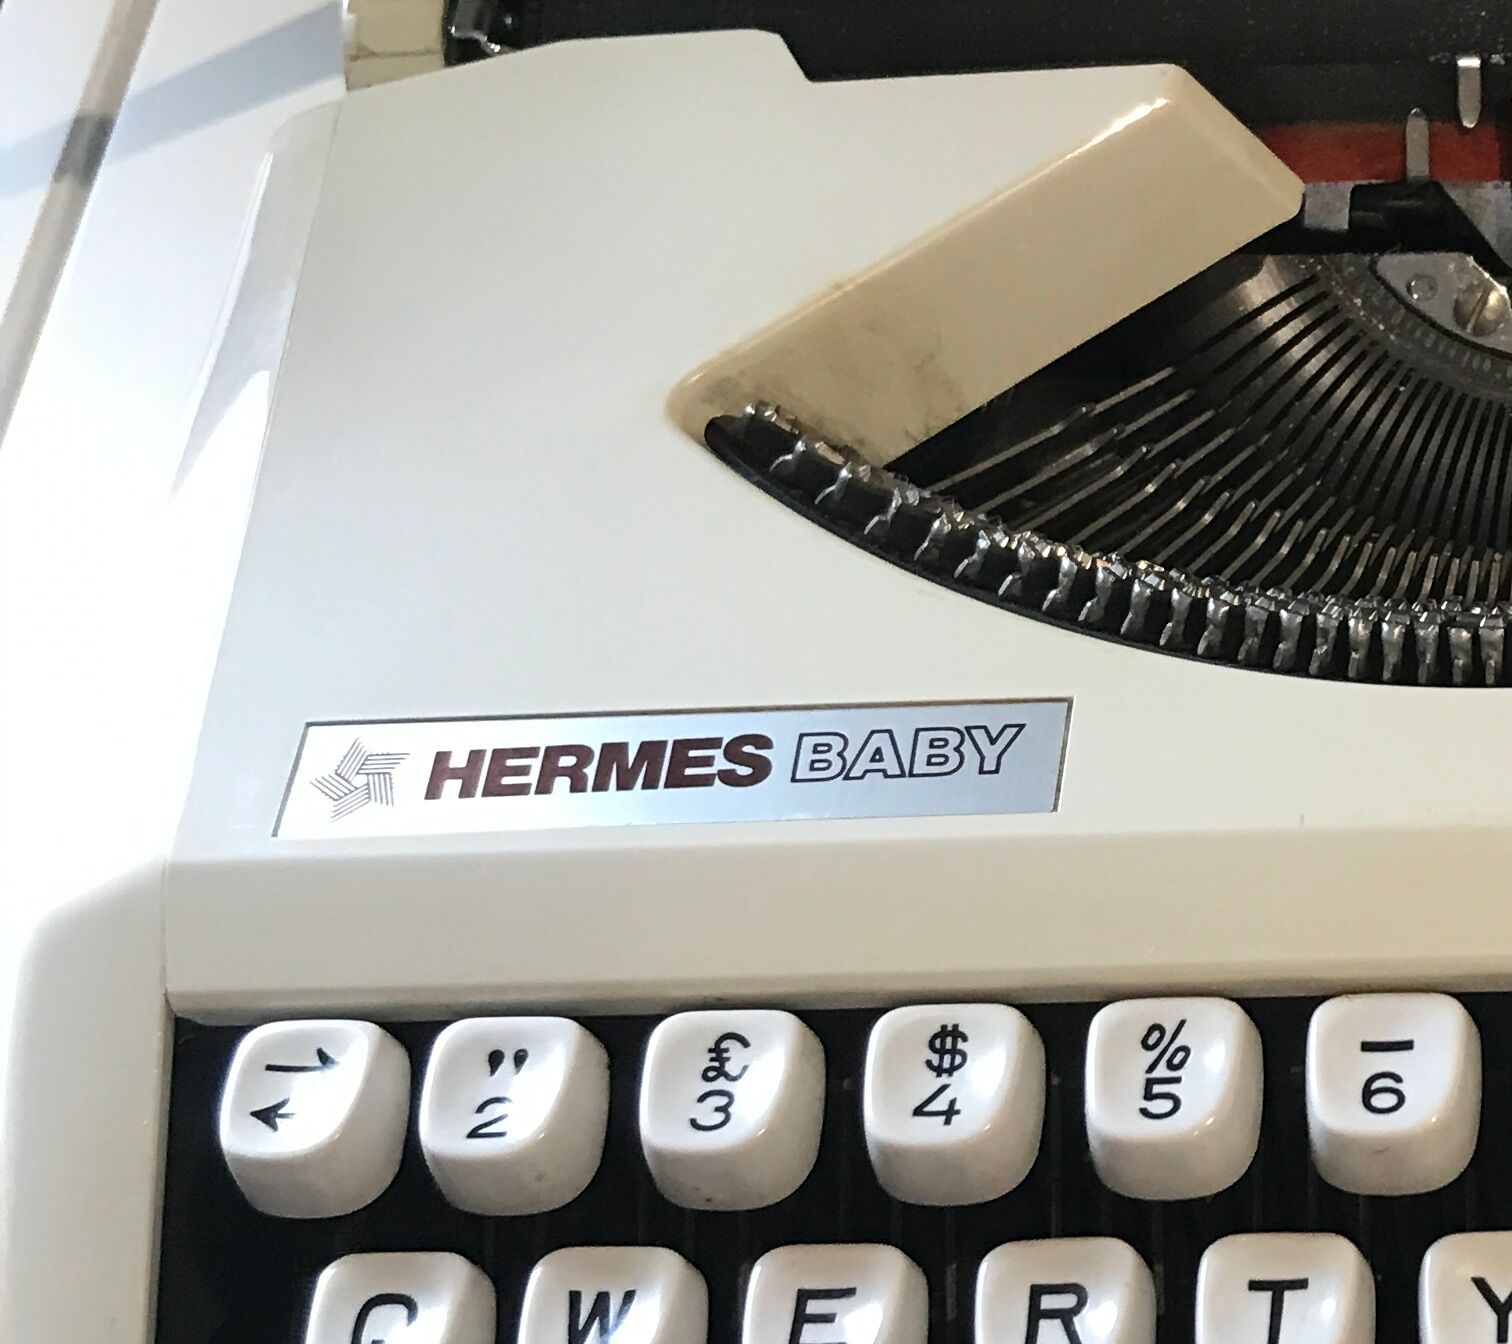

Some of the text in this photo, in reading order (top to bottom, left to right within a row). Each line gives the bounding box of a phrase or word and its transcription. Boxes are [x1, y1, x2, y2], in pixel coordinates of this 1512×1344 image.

[423, 723, 1026, 801] HERMES BABY
[701, 1031, 751, 1083] £
[924, 1023, 969, 1078] $
[1140, 1019, 1191, 1075] %
[689, 1089, 734, 1132] 3
[912, 1083, 961, 1126] 4
[1138, 1076, 1182, 1120] 5
[1361, 1071, 1406, 1115] 6
[466, 1096, 511, 1139] 2
